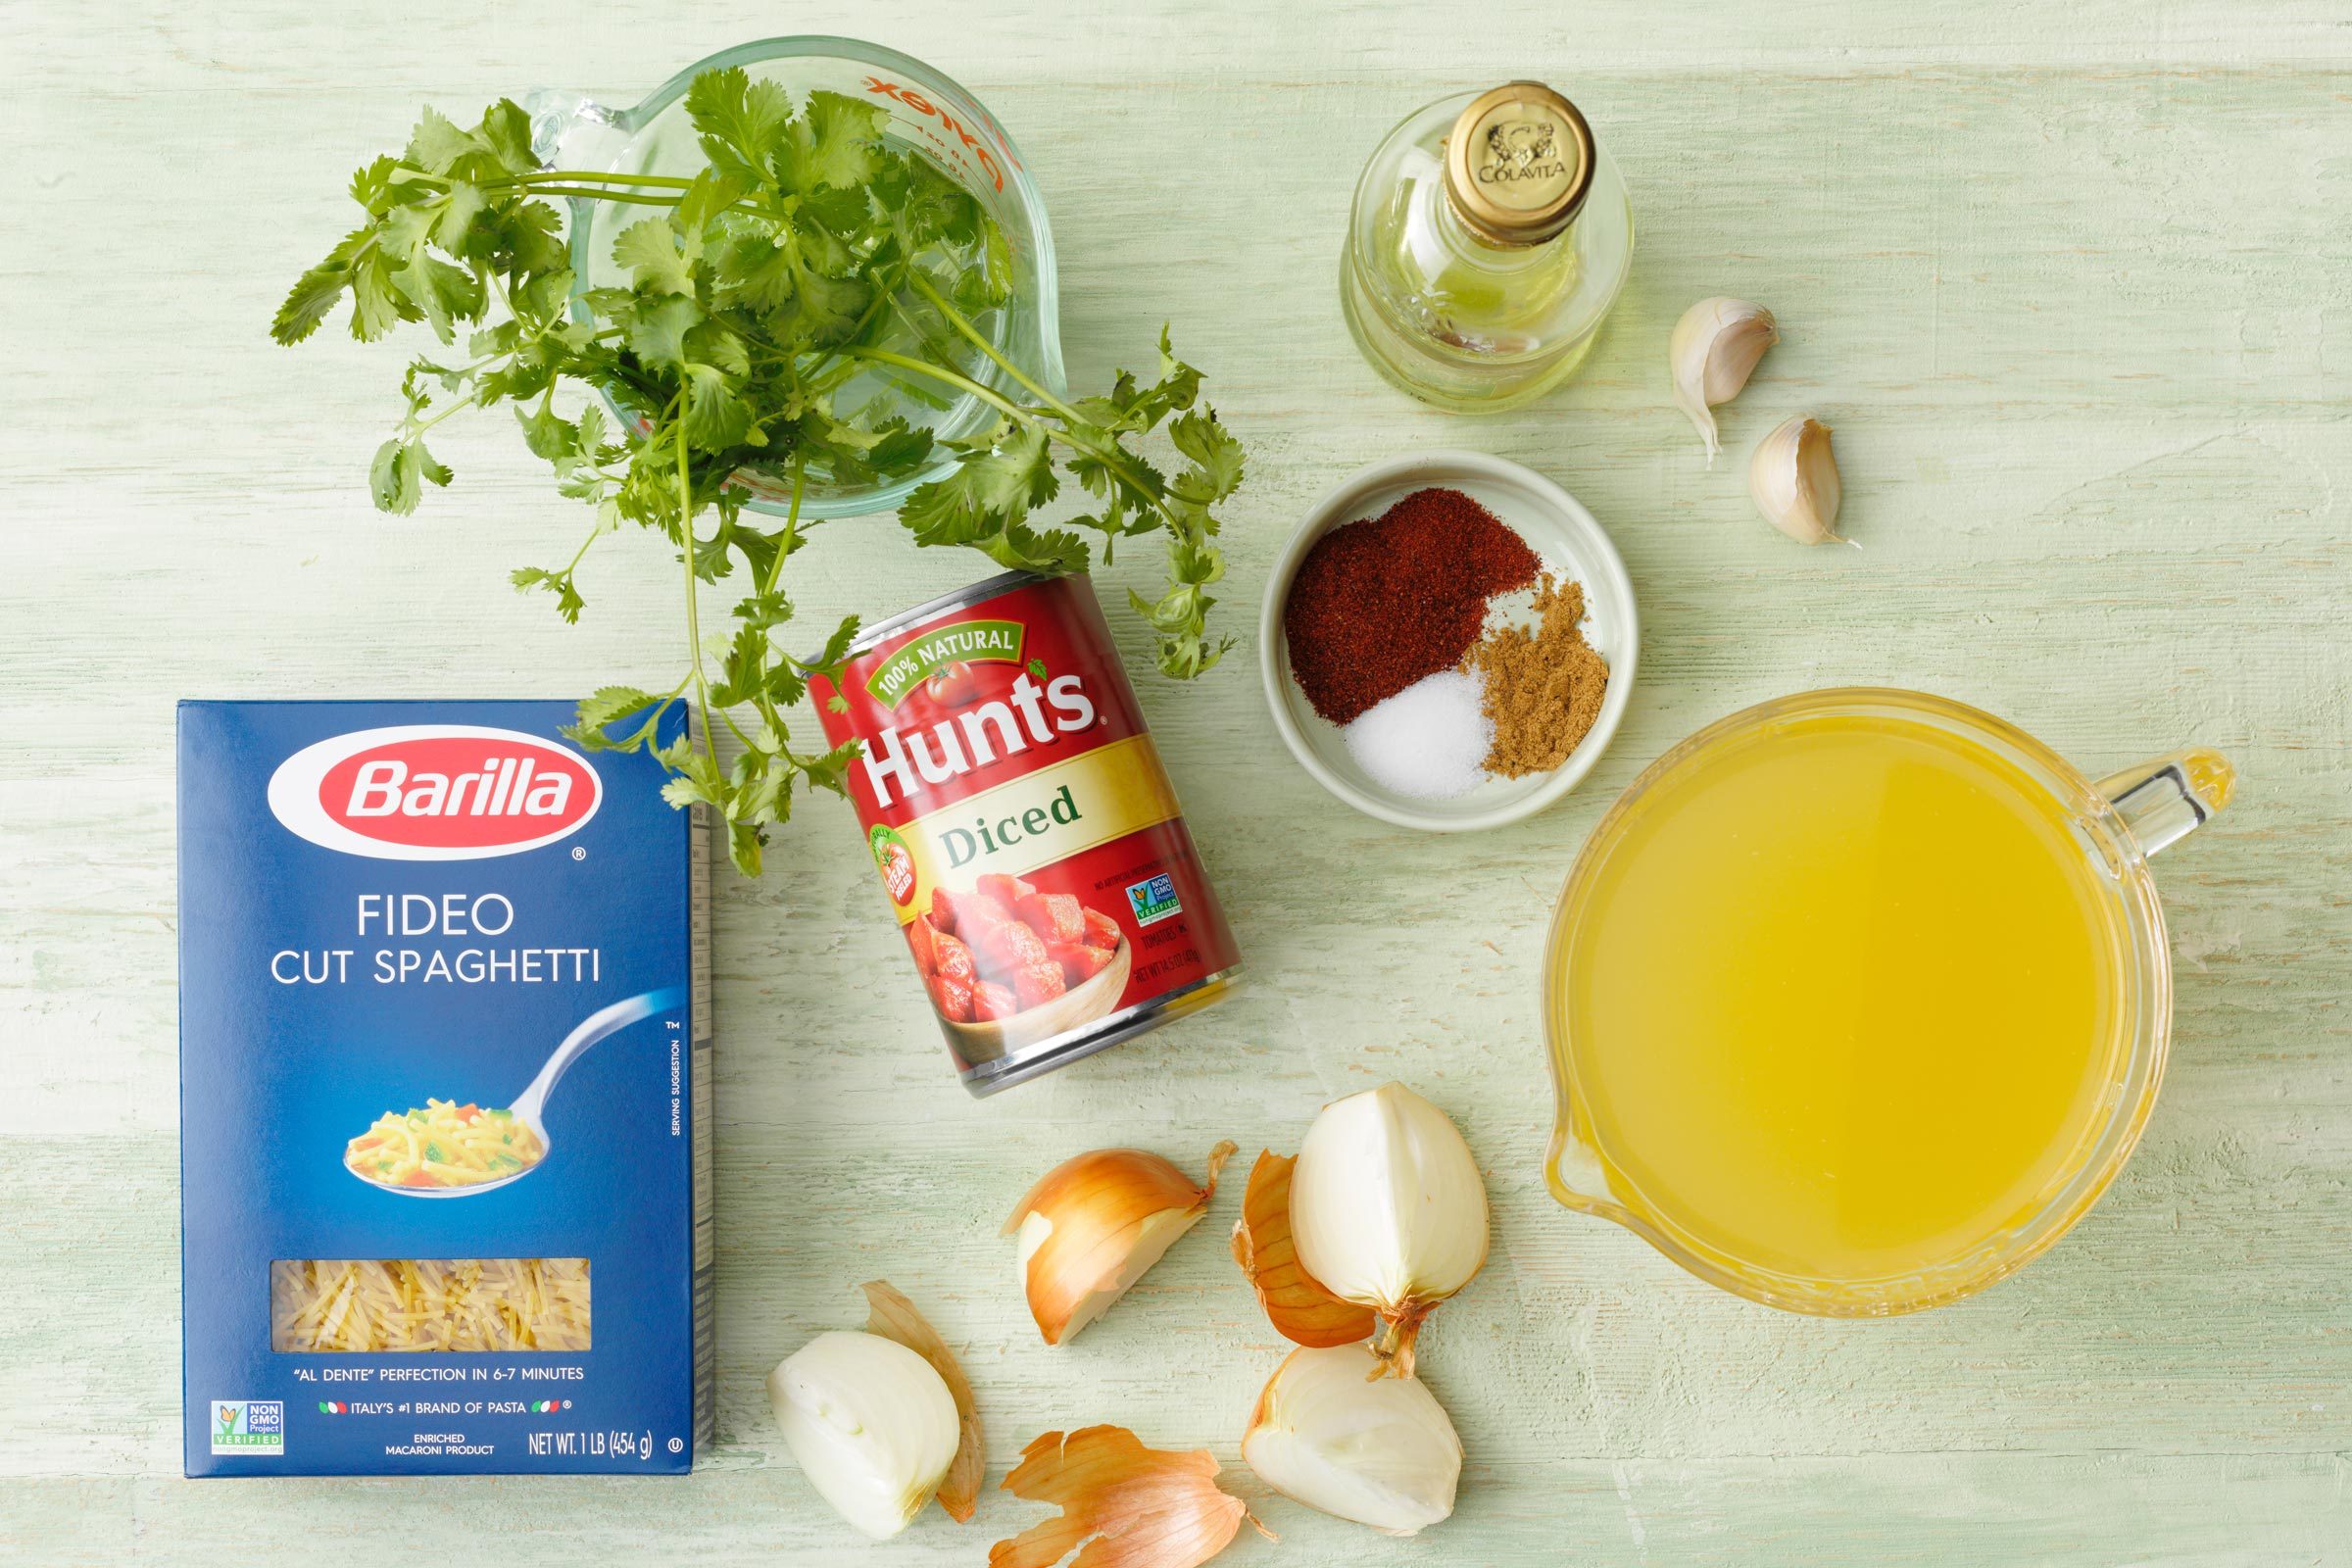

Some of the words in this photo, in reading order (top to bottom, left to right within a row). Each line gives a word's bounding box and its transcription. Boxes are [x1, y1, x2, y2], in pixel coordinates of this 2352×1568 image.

[1479, 162, 1565, 183] COLAVITA
[879, 656, 918, 696] 100%
[917, 630, 1013, 665] NATURAL
[346, 758, 572, 816] Barilla
[939, 785, 1082, 869] Diced
[888, 856, 909, 894] STEAM
[1152, 877, 1169, 888] NON
[896, 872, 912, 901] PEELED
[1154, 884, 1172, 896] GMO
[1156, 891, 1174, 902] Project
[358, 894, 514, 936] FIDEO
[1138, 899, 1178, 918] VERIFIED
[271, 951, 354, 984] CUT
[373, 949, 599, 983] SPAGHETTI
[671, 1040, 680, 1095] SUGGESTION
[671, 1099, 680, 1136] SERVING
[294, 1368, 318, 1381] "AL
[323, 1368, 374, 1381] DENTE"
[380, 1368, 466, 1381] PERFECTION
[472, 1368, 487, 1380] IN
[493, 1367, 515, 1380] 6-7
[522, 1367, 584, 1380] MINUTES
[250, 1405, 278, 1414] NON
[351, 1402, 393, 1413] ITALY'S
[398, 1402, 410, 1413] #1
[416, 1402, 461, 1413] BRAND
[465, 1401, 482, 1413] OF
[488, 1401, 526, 1412] PASTA
[250, 1415, 279, 1424] GMO
[250, 1425, 279, 1434] Project
[414, 1434, 465, 1444] ENRICHED
[529, 1433, 553, 1454] NET
[556, 1433, 576, 1454] WT.
[580, 1433, 585, 1454] 1
[590, 1433, 605, 1454] LB
[610, 1430, 635, 1458] (454
[386, 1446, 442, 1455] MACARONI
[446, 1446, 494, 1455] PRODUCT
